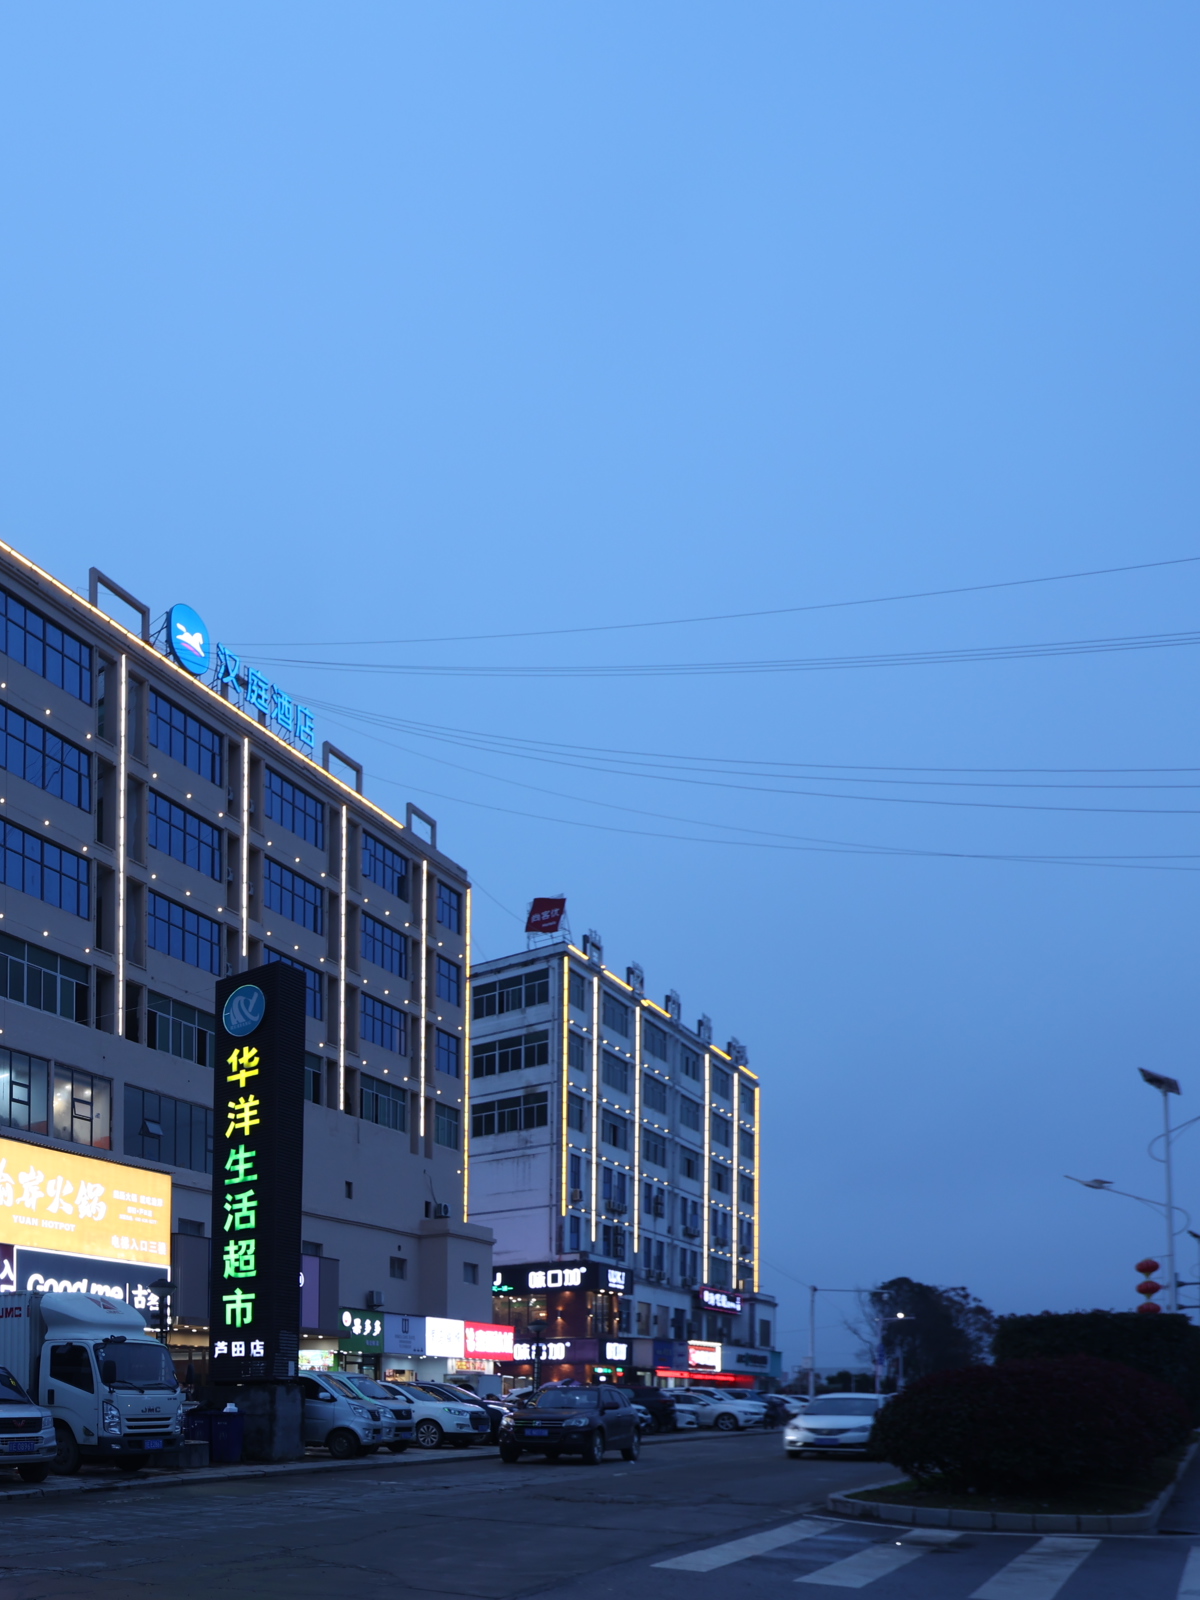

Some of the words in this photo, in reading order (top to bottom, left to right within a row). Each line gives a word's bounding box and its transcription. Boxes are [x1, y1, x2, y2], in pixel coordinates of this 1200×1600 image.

[217, 642, 315, 749] 汉庭酒店
[223, 1046, 261, 1328] 华洋生活超市
[12, 1214, 39, 1227] YUAN
[41, 1219, 76, 1232] HOTPOT
[26, 1273, 88, 1294] Good
[90, 1283, 124, 1300] me
[214, 1340, 265, 1359] 芦田店
